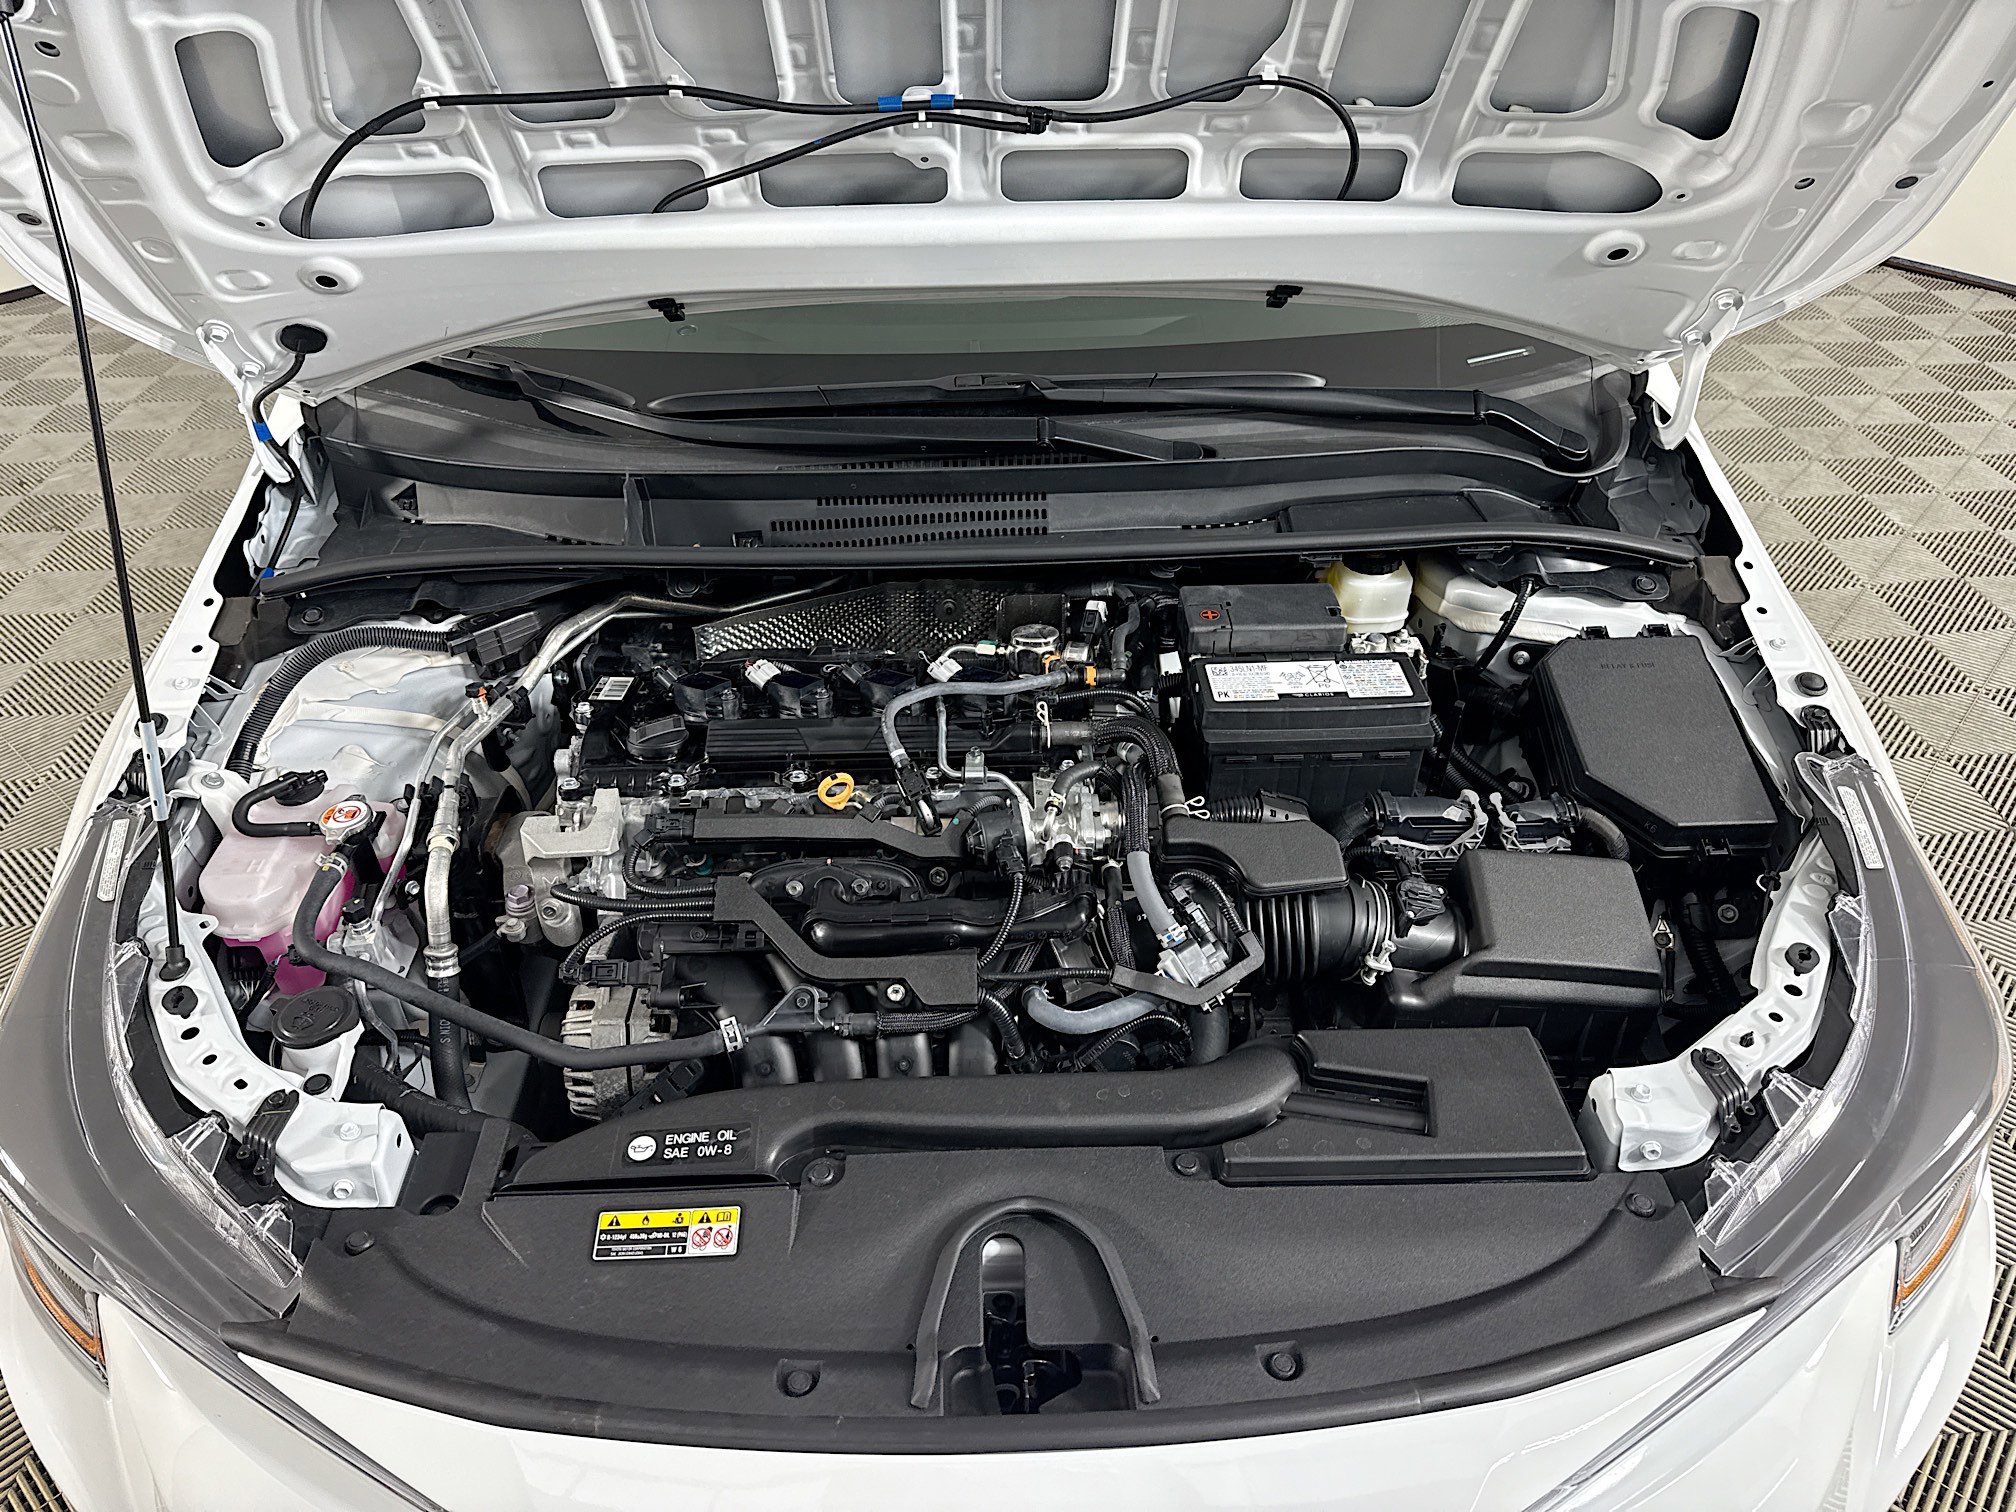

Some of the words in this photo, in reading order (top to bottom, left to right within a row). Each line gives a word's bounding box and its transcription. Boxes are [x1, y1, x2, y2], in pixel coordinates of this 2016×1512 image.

[664, 1131, 710, 1145] ENGINE
[717, 1129, 737, 1141] OIL
[663, 1146, 689, 1159] SAE
[697, 1143, 732, 1157] 0W-8
